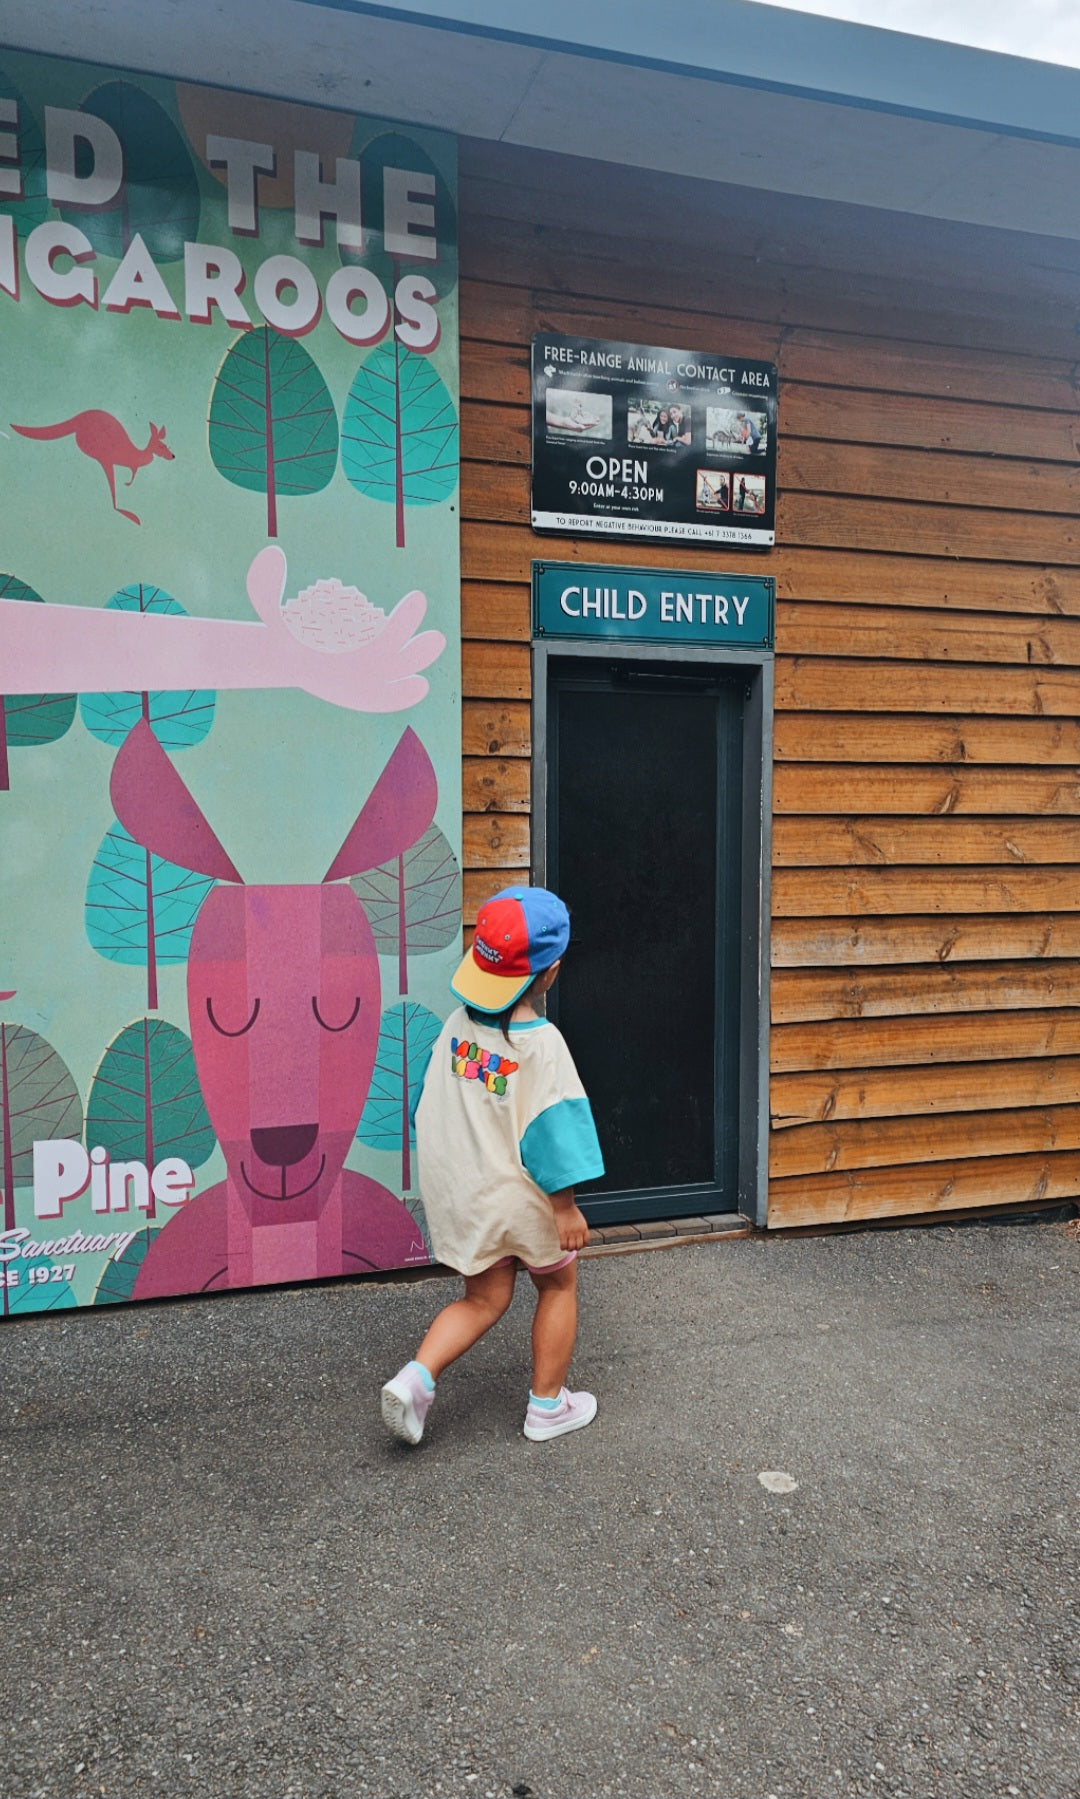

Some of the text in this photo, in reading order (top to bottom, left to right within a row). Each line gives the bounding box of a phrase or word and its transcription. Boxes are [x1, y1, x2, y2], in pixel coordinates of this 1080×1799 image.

[205, 134, 438, 261] THE
[544, 346, 770, 388] FREE-RANGE ANIMAL CONTACT AREA
[586, 456, 649, 484] OPEN
[568, 481, 664, 502] 9:00AM-4:30PM
[556, 517, 566, 525] TO
[568, 518, 593, 527] REPORT
[596, 520, 625, 530] NEGATIVE
[628, 523, 662, 533] BEHAVIOUR
[664, 526, 685, 535] PLEASE
[687, 528, 702, 537] CALL
[560, 586, 750, 626] CHILD ENTRY
[33, 1139, 194, 1218] Pine
[0, 1227, 137, 1263] Sanctuary
[29, 1264, 75, 1284] 1927
